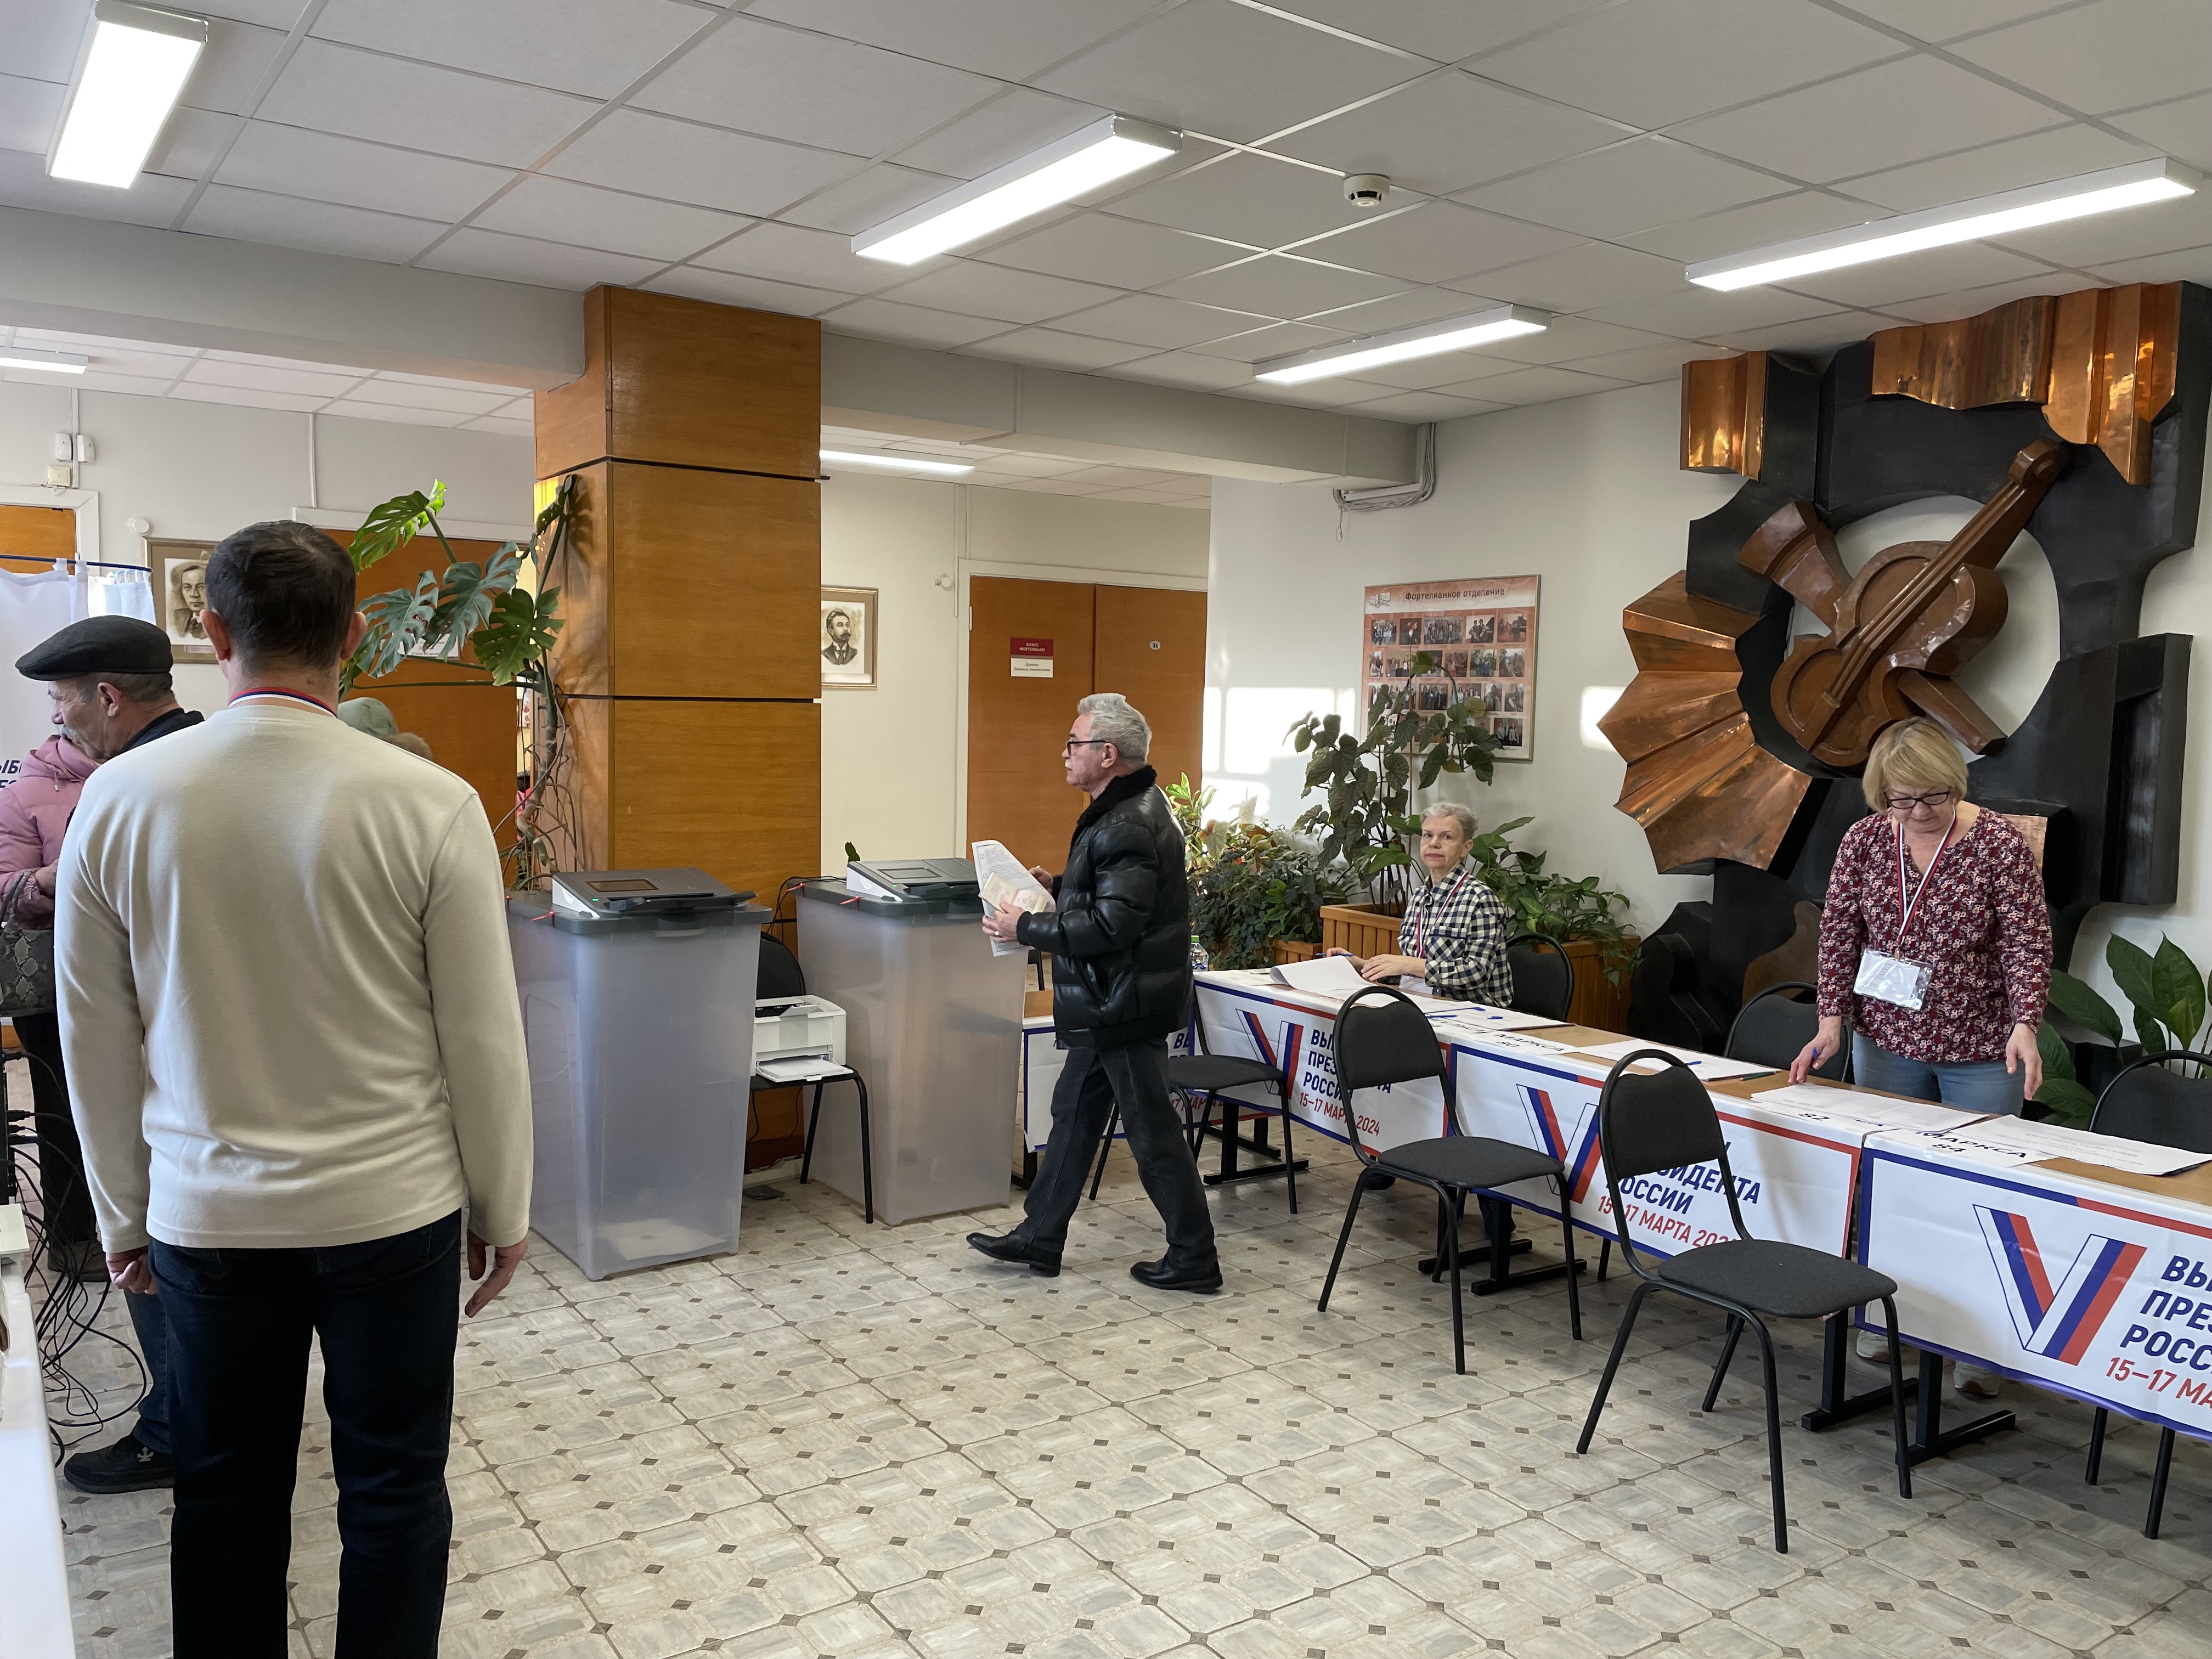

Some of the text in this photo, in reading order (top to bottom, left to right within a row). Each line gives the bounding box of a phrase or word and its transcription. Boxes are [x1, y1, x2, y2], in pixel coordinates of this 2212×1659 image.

[1405, 588, 1505, 601] Фортепианное отделение
[1494, 1034, 1564, 1052] МАРКСА
[1355, 1115, 1380, 1136] 2024
[1932, 1144, 1966, 1152] 84
[1606, 1176, 1694, 1215] ОССИИ
[1639, 1210, 1692, 1244] МАРТА
[2160, 1255, 2212, 1292] ВЫ
[2140, 1289, 2212, 1334] ПРЕ
[2119, 1324, 2212, 1374] РОСС
[2175, 1378, 2212, 1409] МА
